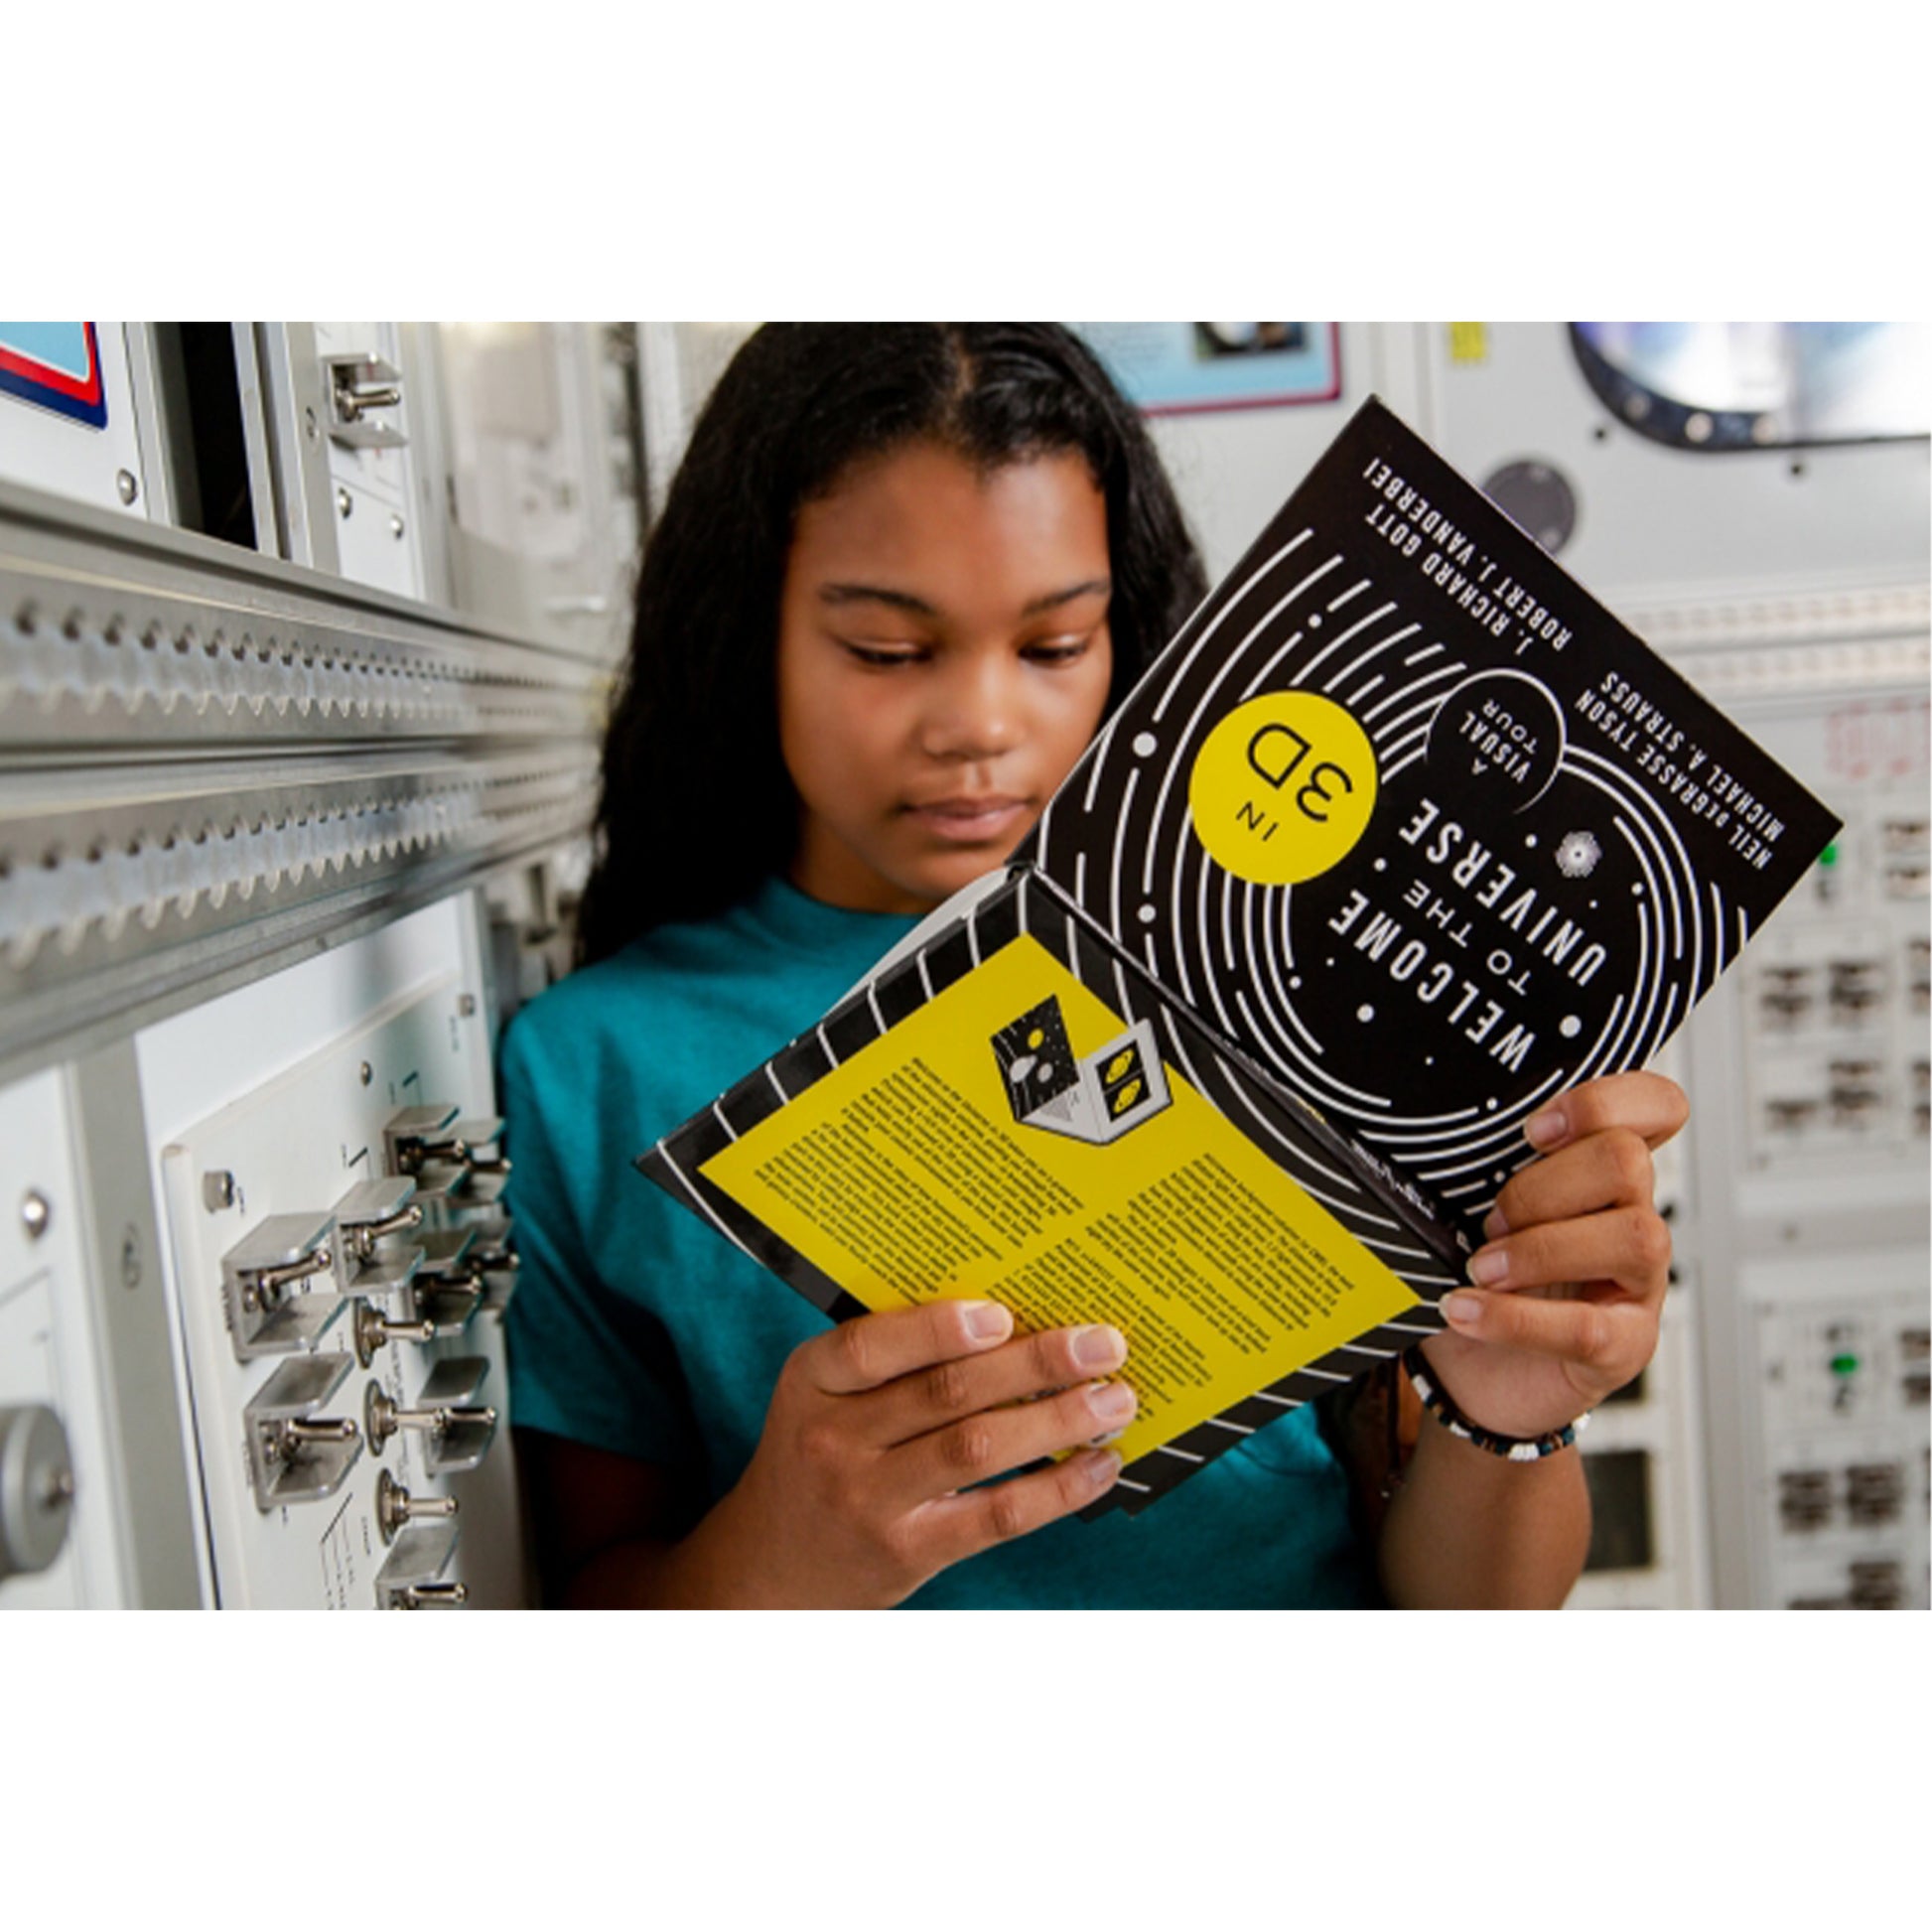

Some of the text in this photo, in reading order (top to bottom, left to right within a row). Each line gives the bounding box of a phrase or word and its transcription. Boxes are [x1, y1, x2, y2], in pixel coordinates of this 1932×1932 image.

[1363, 458, 1573, 651] ROBERT J. VANDERBEI
[1365, 503, 1534, 655] J. RICHARD GOTT
[1459, 711, 1531, 782] VISUAL
[1472, 759, 1488, 774] A
[1482, 700, 1537, 755] TOUR
[1576, 689, 1638, 752] TYSON
[1600, 671, 1784, 842] MICHAEL A. STRAUSS
[1236, 801, 1278, 841] IN
[1247, 723, 1353, 822] 3D
[1398, 798, 1606, 987] UNIVERSE
[1728, 824, 1772, 870] NEIL
[1328, 890, 1535, 1072] WELCOME
[1403, 880, 1531, 996] TO THE
